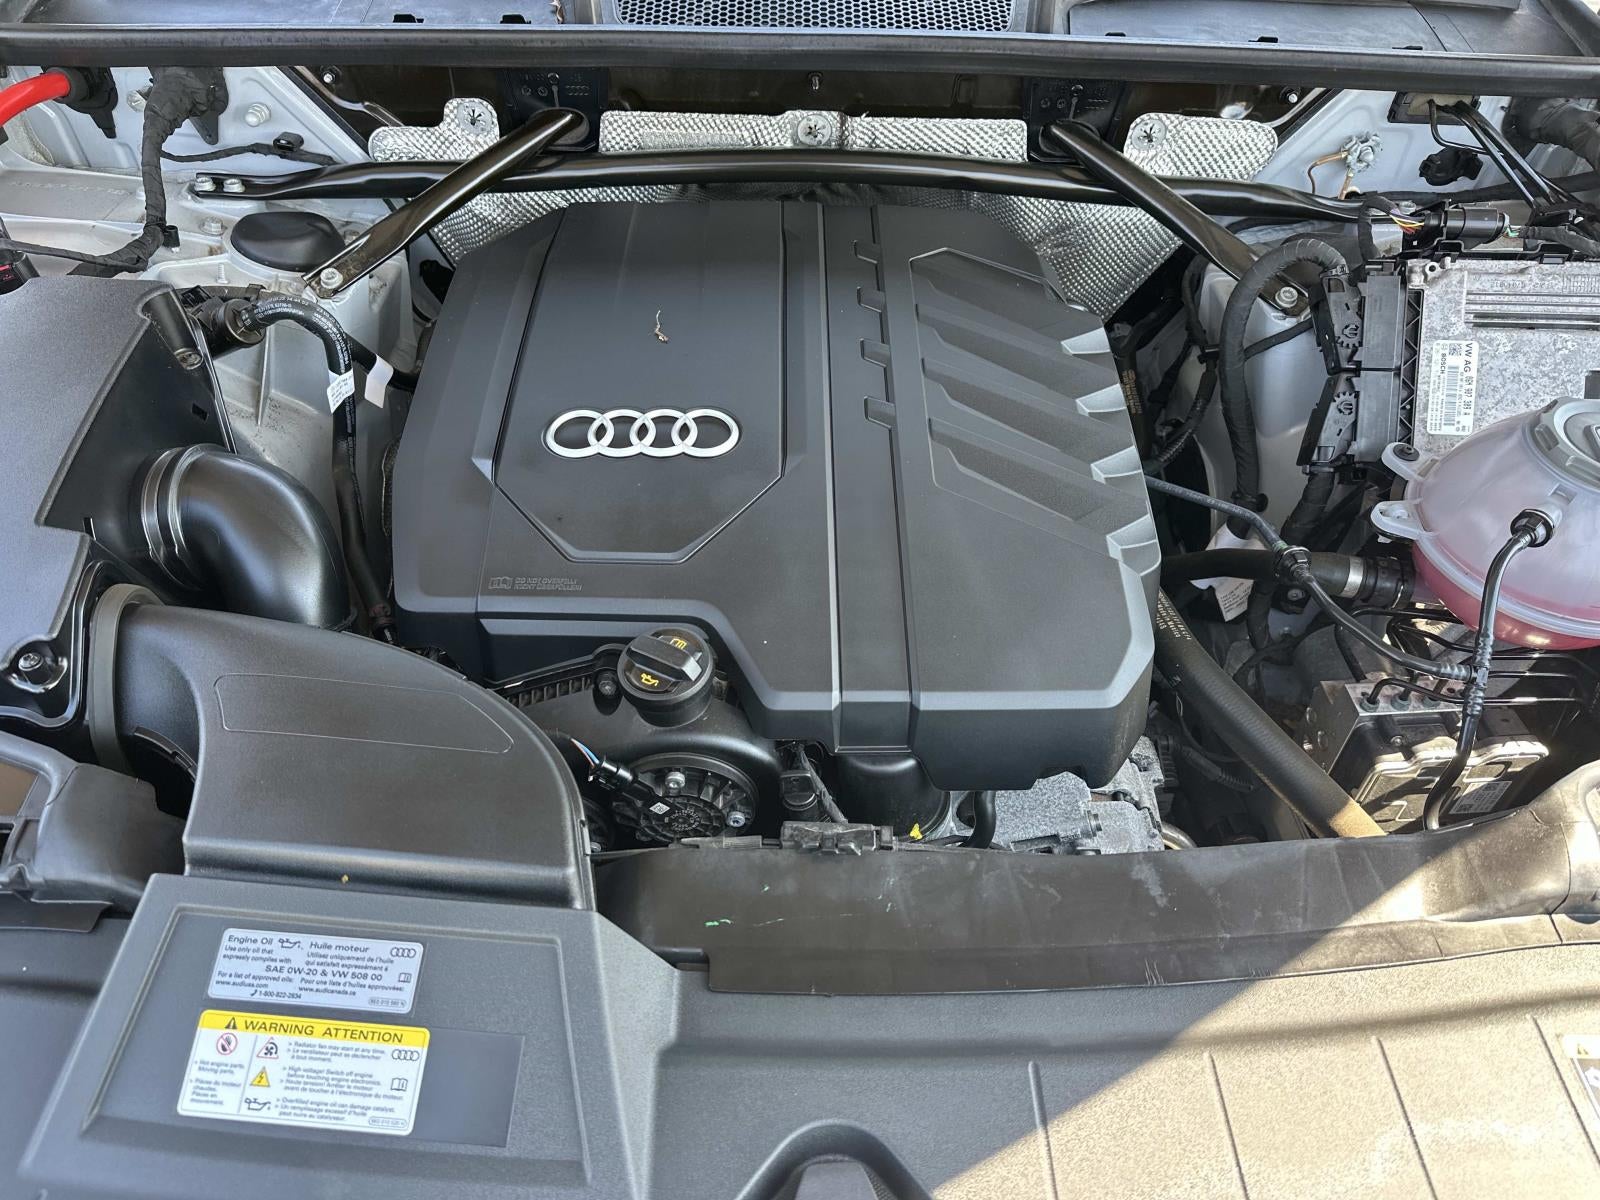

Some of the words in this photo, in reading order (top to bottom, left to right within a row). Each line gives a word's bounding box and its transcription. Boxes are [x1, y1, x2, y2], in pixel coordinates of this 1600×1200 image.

[1465, 343, 1473, 358] VW
[1464, 359, 1472, 373] AG
[228, 934, 258, 944] Engine
[261, 937, 274, 945] Oil
[310, 941, 333, 950] Huile
[335, 944, 370, 952] moteur
[265, 965, 285, 974] SAE
[287, 967, 318, 976] 0W-20
[320, 969, 328, 977] &
[331, 970, 350, 978] VW
[351, 972, 368, 980] 508
[370, 974, 382, 982] 00
[244, 1020, 314, 1036] WARNING
[322, 1028, 404, 1044] ATTENTION
